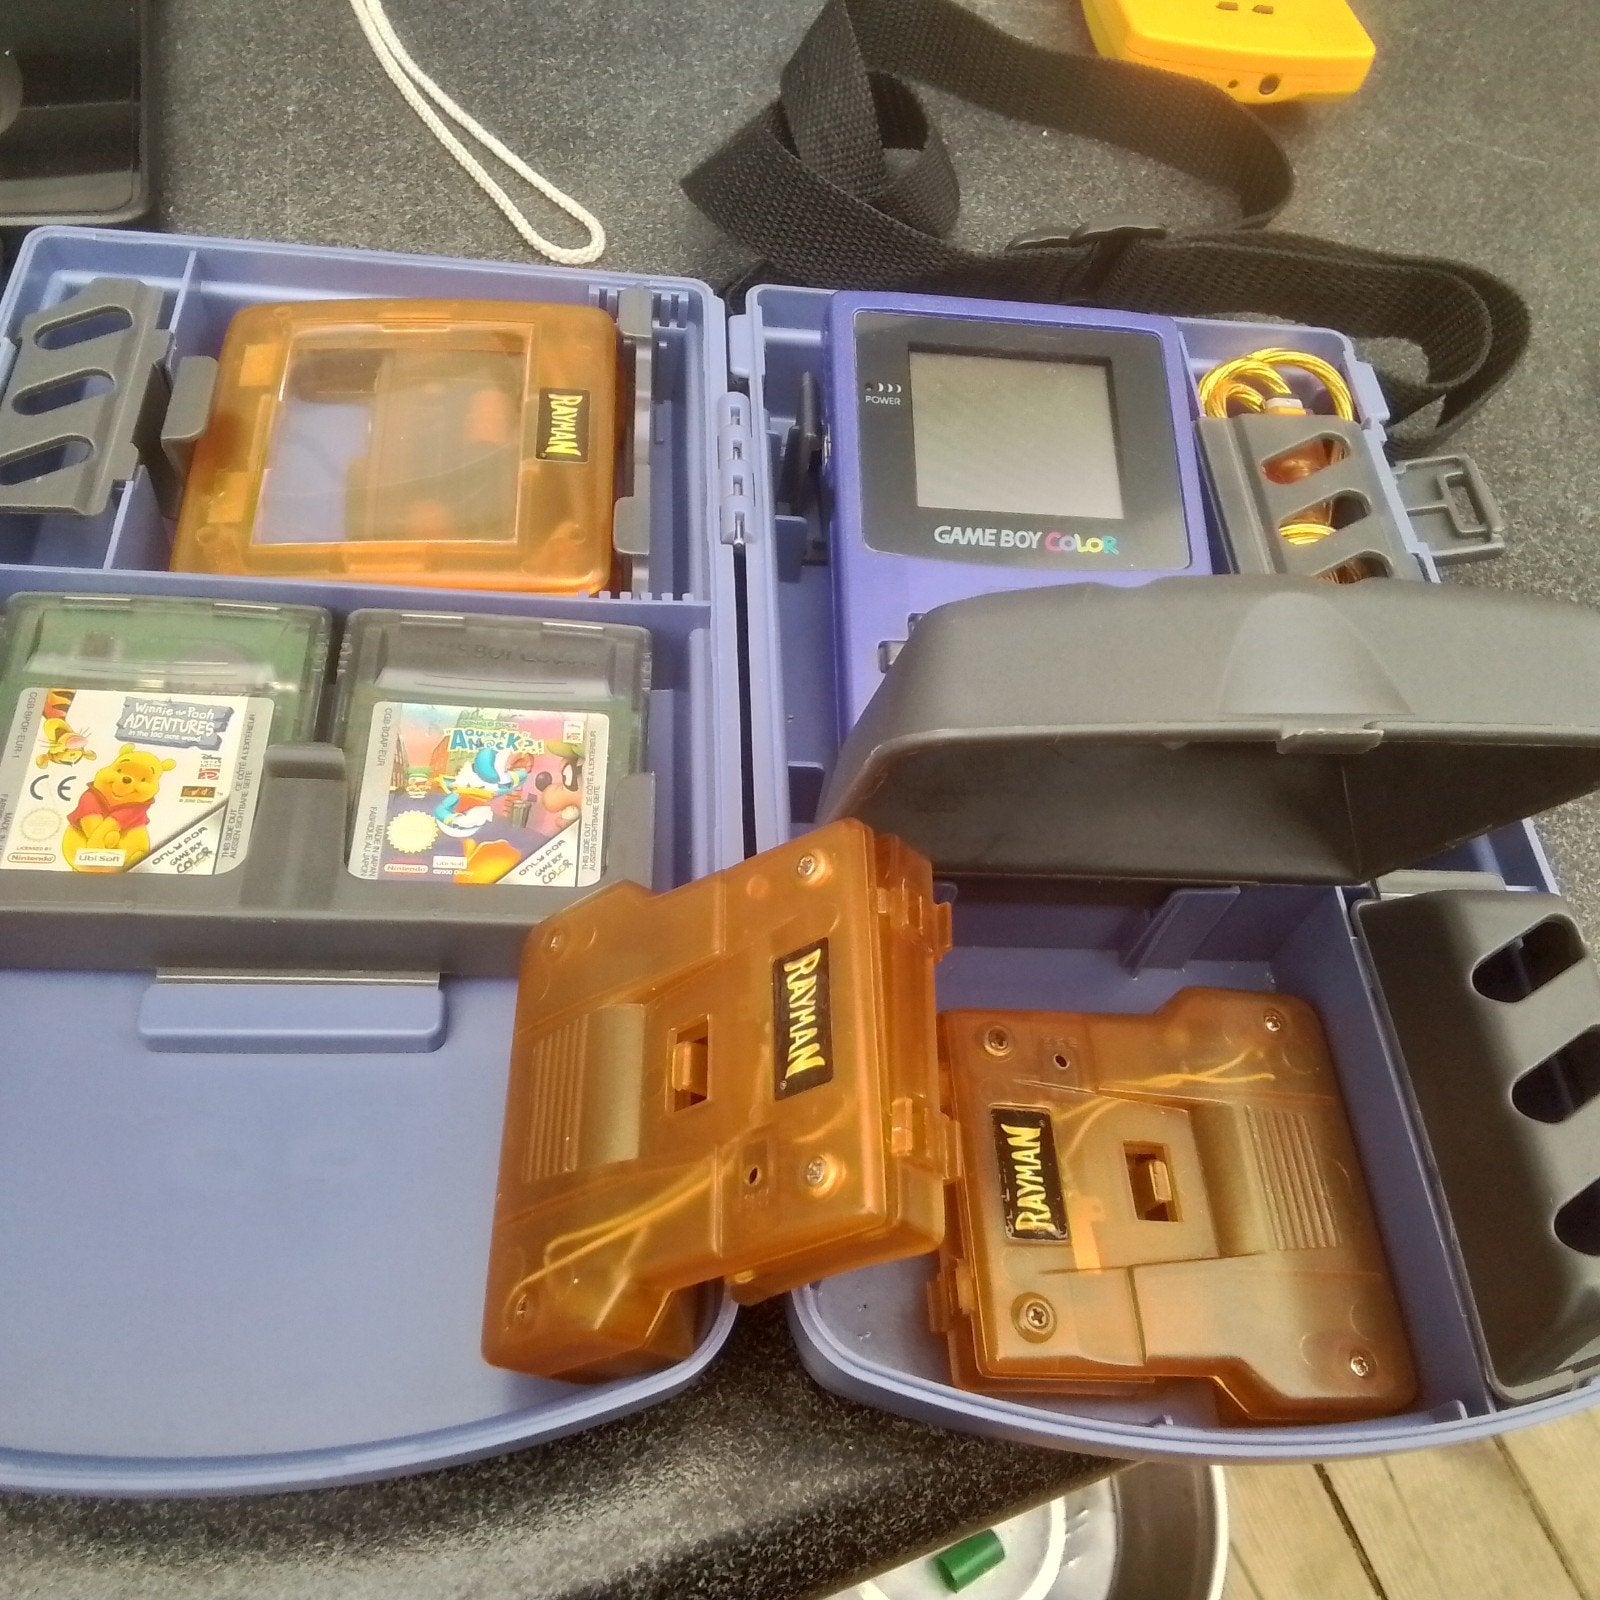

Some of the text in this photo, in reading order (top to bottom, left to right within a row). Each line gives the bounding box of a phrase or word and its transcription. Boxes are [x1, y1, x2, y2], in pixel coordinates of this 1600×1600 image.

[865, 395, 901, 406] POWER
[545, 394, 583, 456] RAYMAN
[934, 526, 1119, 555] GAME BOY COLOR
[135, 702, 174, 716] Winnie
[187, 706, 215, 720] Pooh
[123, 712, 215, 737] ADVENTURES
[137, 730, 149, 738] the
[150, 731, 163, 739] 100
[181, 734, 201, 742] wood
[593, 787, 601, 804] SEITE
[229, 830, 241, 859] AUSSEN
[243, 770, 253, 788] SEITE
[221, 808, 237, 858] THIS SIDE OUT
[152, 842, 183, 865] ONLY
[169, 849, 190, 866] GAME
[363, 841, 372, 852] AU
[369, 824, 384, 877] MADE IN JAPAN
[589, 842, 598, 871] AUSSEN
[11, 854, 54, 862] Nintendo
[79, 854, 120, 863] Ubi Soft
[360, 852, 370, 877] JAPON
[519, 854, 545, 876] ONLY
[535, 859, 552, 878] GAME
[581, 854, 589, 871] THIS
[783, 948, 826, 1080] RAYMAN
[1001, 1122, 1055, 1232] RAYMAN
